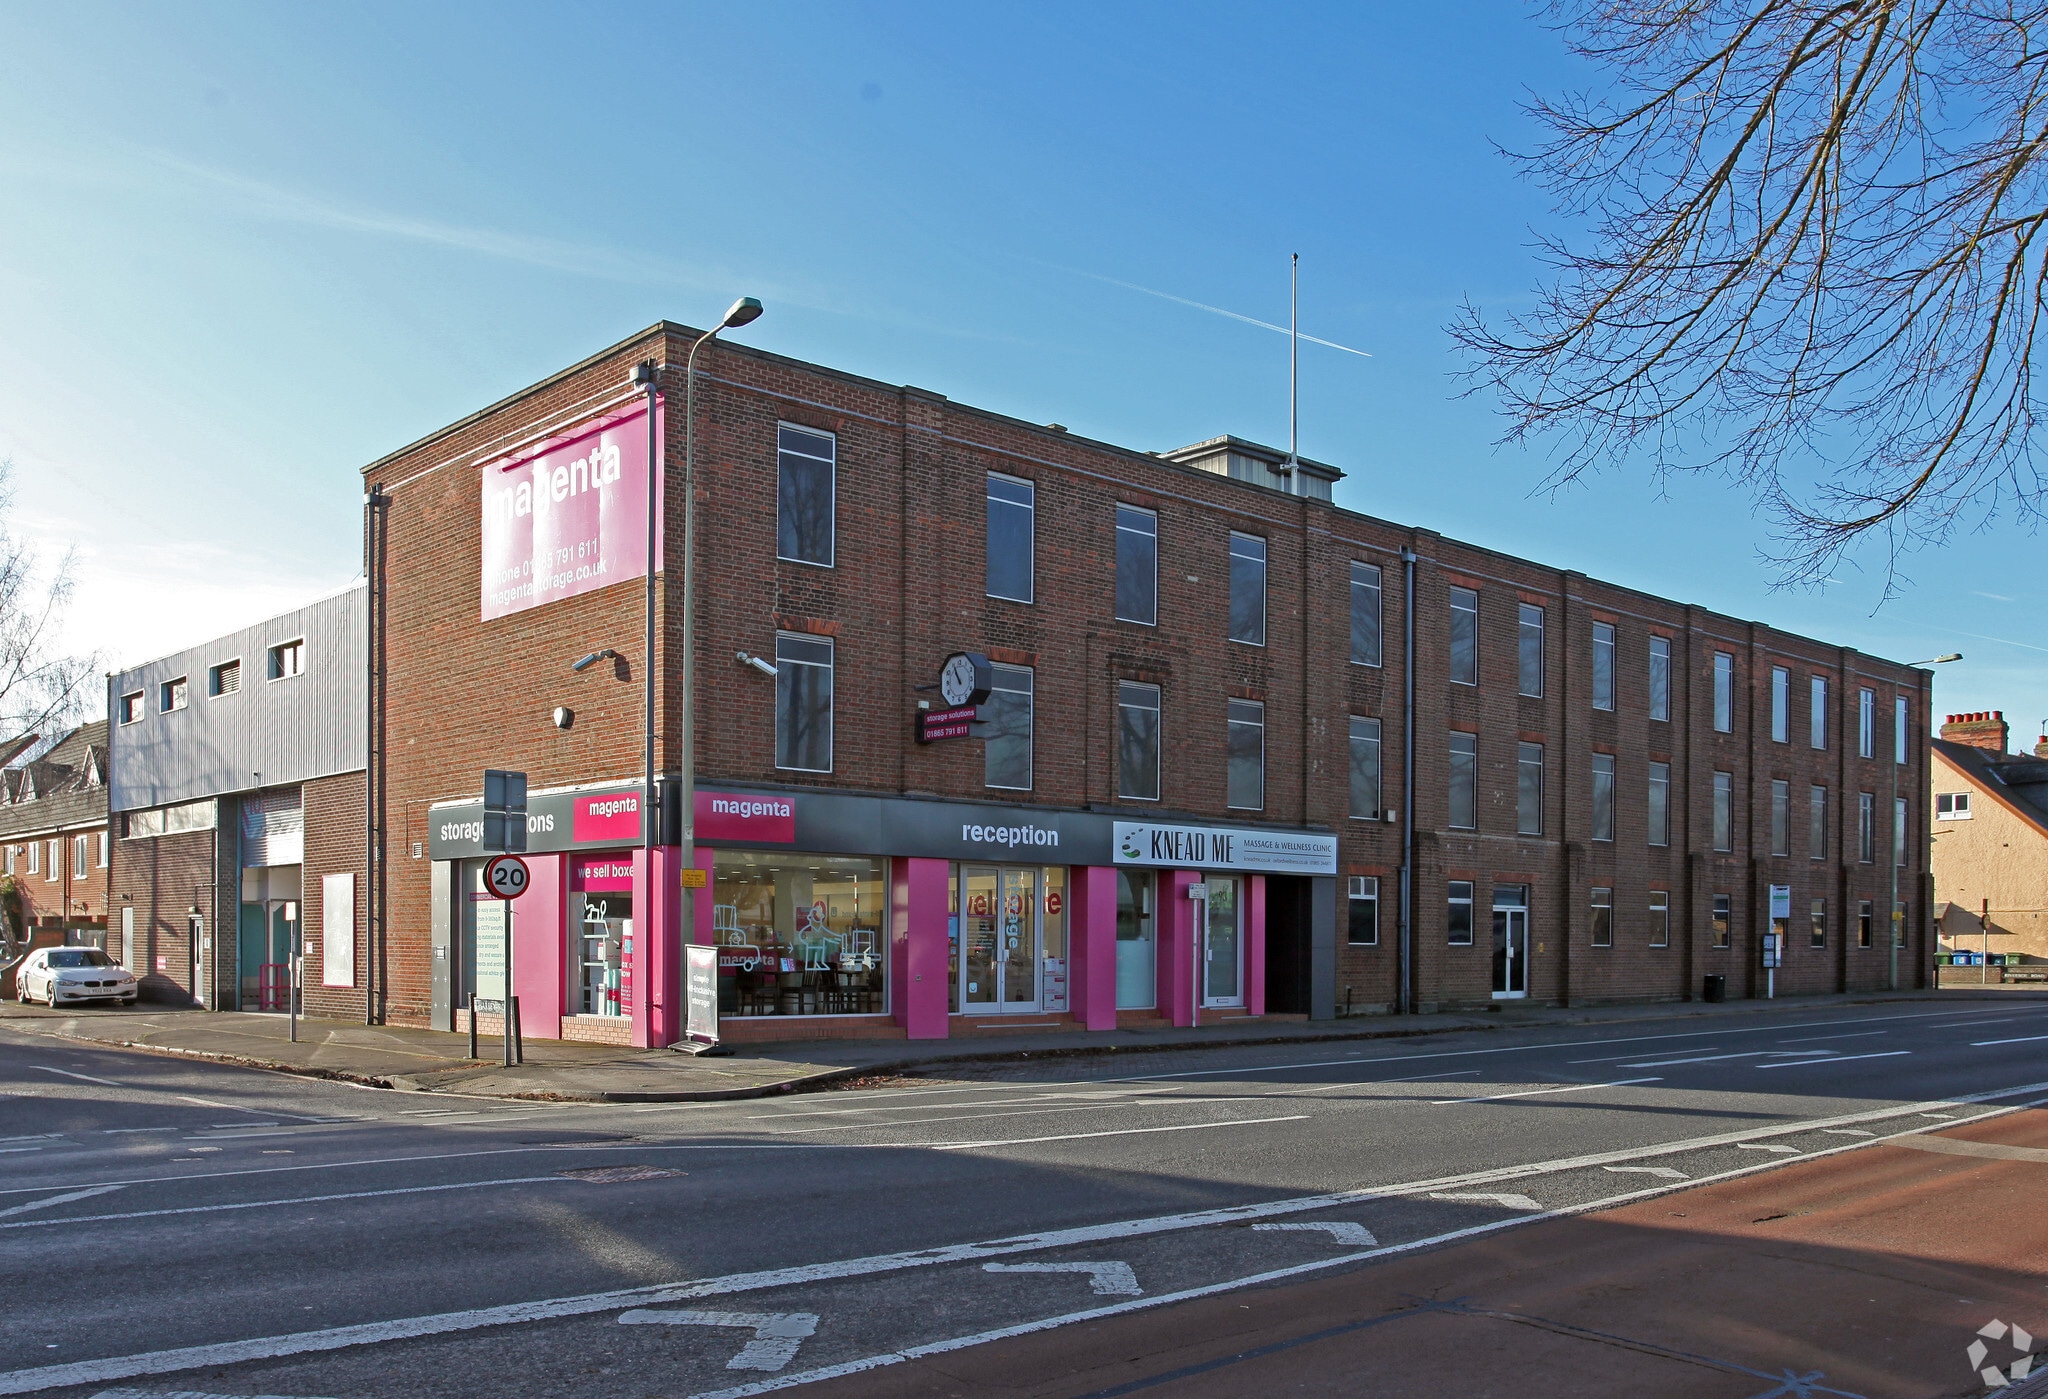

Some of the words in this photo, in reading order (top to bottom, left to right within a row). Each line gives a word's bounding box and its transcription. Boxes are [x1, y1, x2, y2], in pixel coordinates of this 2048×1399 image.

[489, 444, 621, 521] magenta
[557, 545, 575, 566] 791
[578, 537, 598, 558] 611
[927, 713, 947, 722] storage
[948, 709, 975, 719] solutions
[945, 727, 956, 736] 791
[589, 798, 637, 818] magenta
[712, 799, 791, 818] magenta
[962, 824, 1059, 848] reception
[1151, 829, 1205, 862] KNEAD
[1212, 833, 1235, 863] ME
[1243, 839, 1273, 849] MASSAGE
[1274, 841, 1280, 849] &
[1281, 842, 1311, 852] WELLNESS
[1312, 844, 1332, 853] CLINIC
[494, 867, 525, 887] 20
[577, 868, 590, 879] we
[592, 864, 610, 878] sell
[719, 954, 775, 967] magenta
